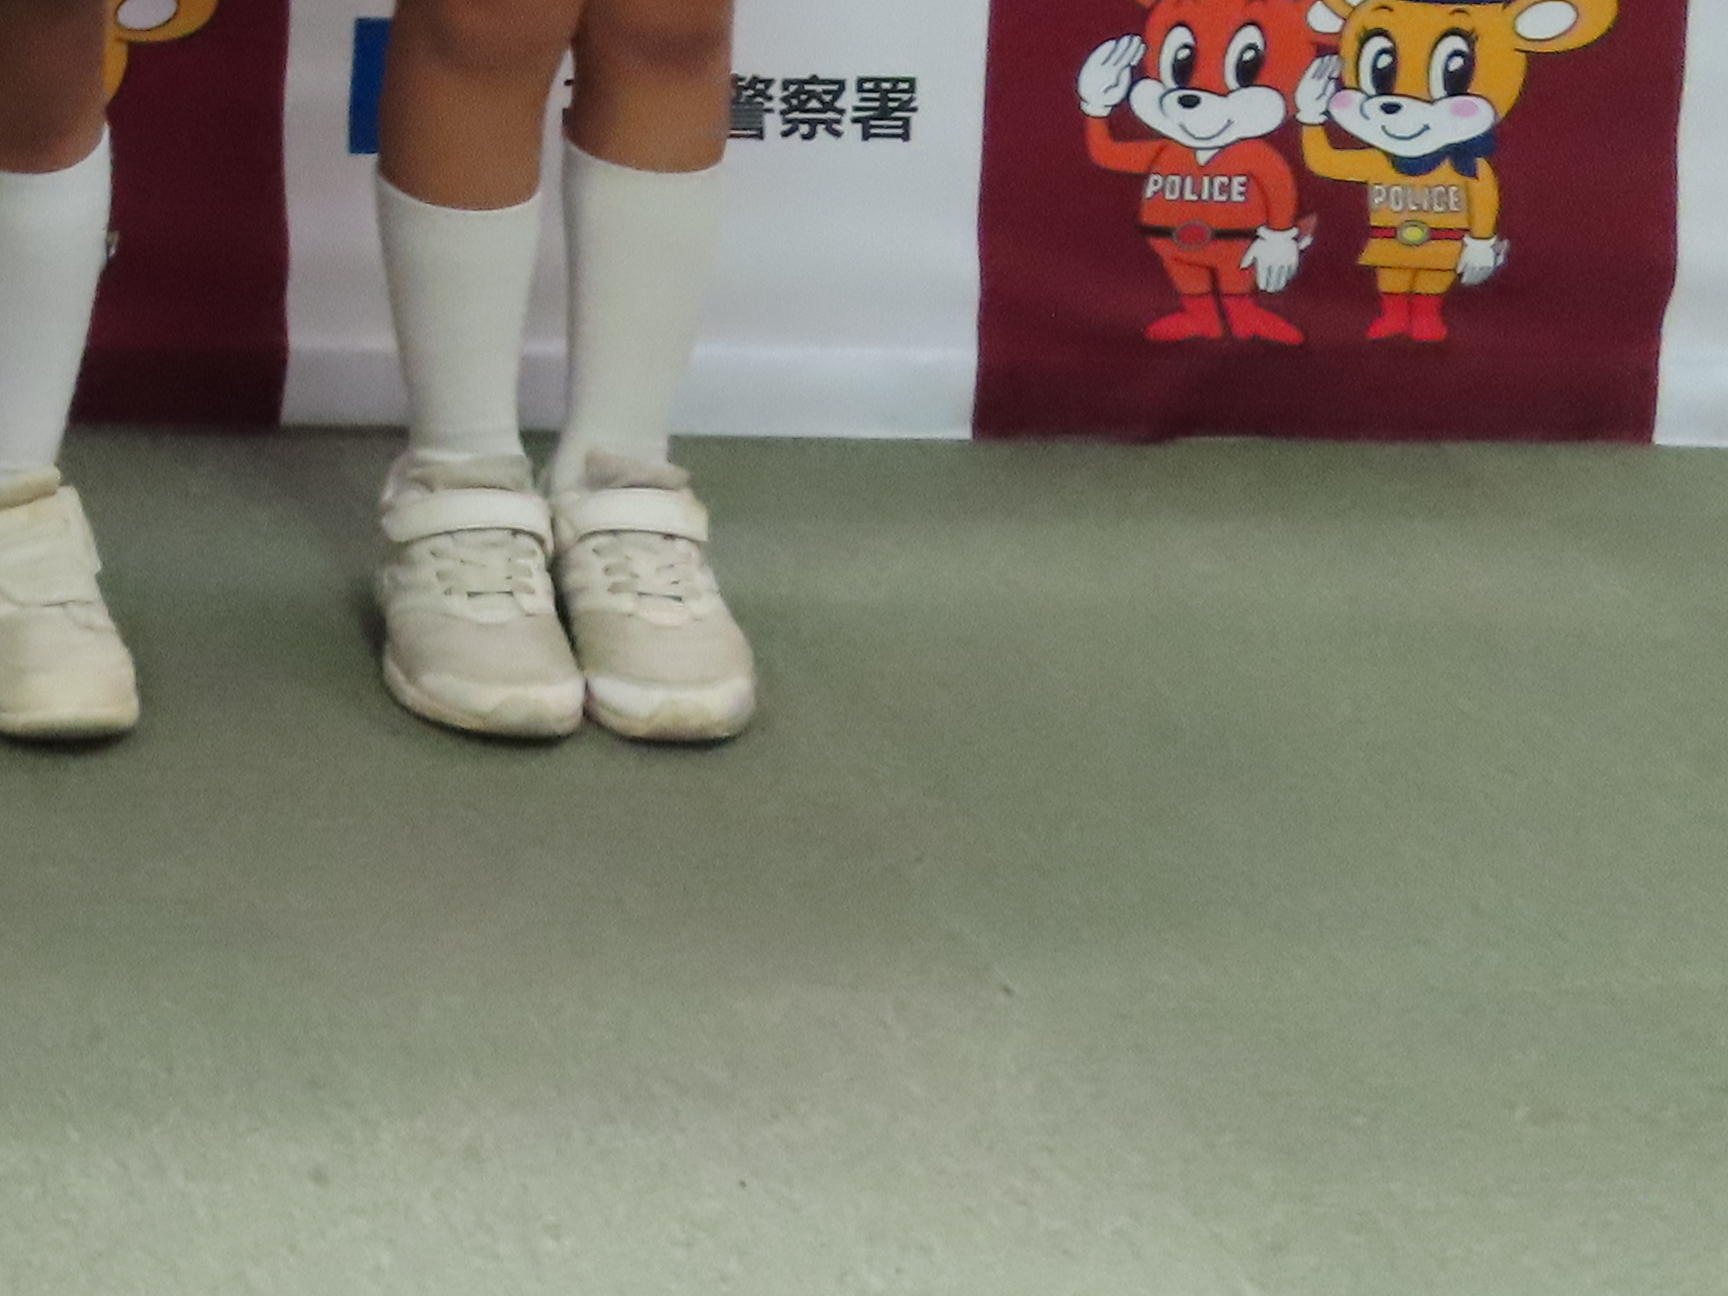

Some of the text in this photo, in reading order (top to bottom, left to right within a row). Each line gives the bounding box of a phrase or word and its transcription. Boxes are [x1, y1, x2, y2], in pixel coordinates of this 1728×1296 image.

[729, 73, 919, 143] 警察署
[1145, 173, 1249, 203] POLICE
[1369, 182, 1462, 213] POLICE
